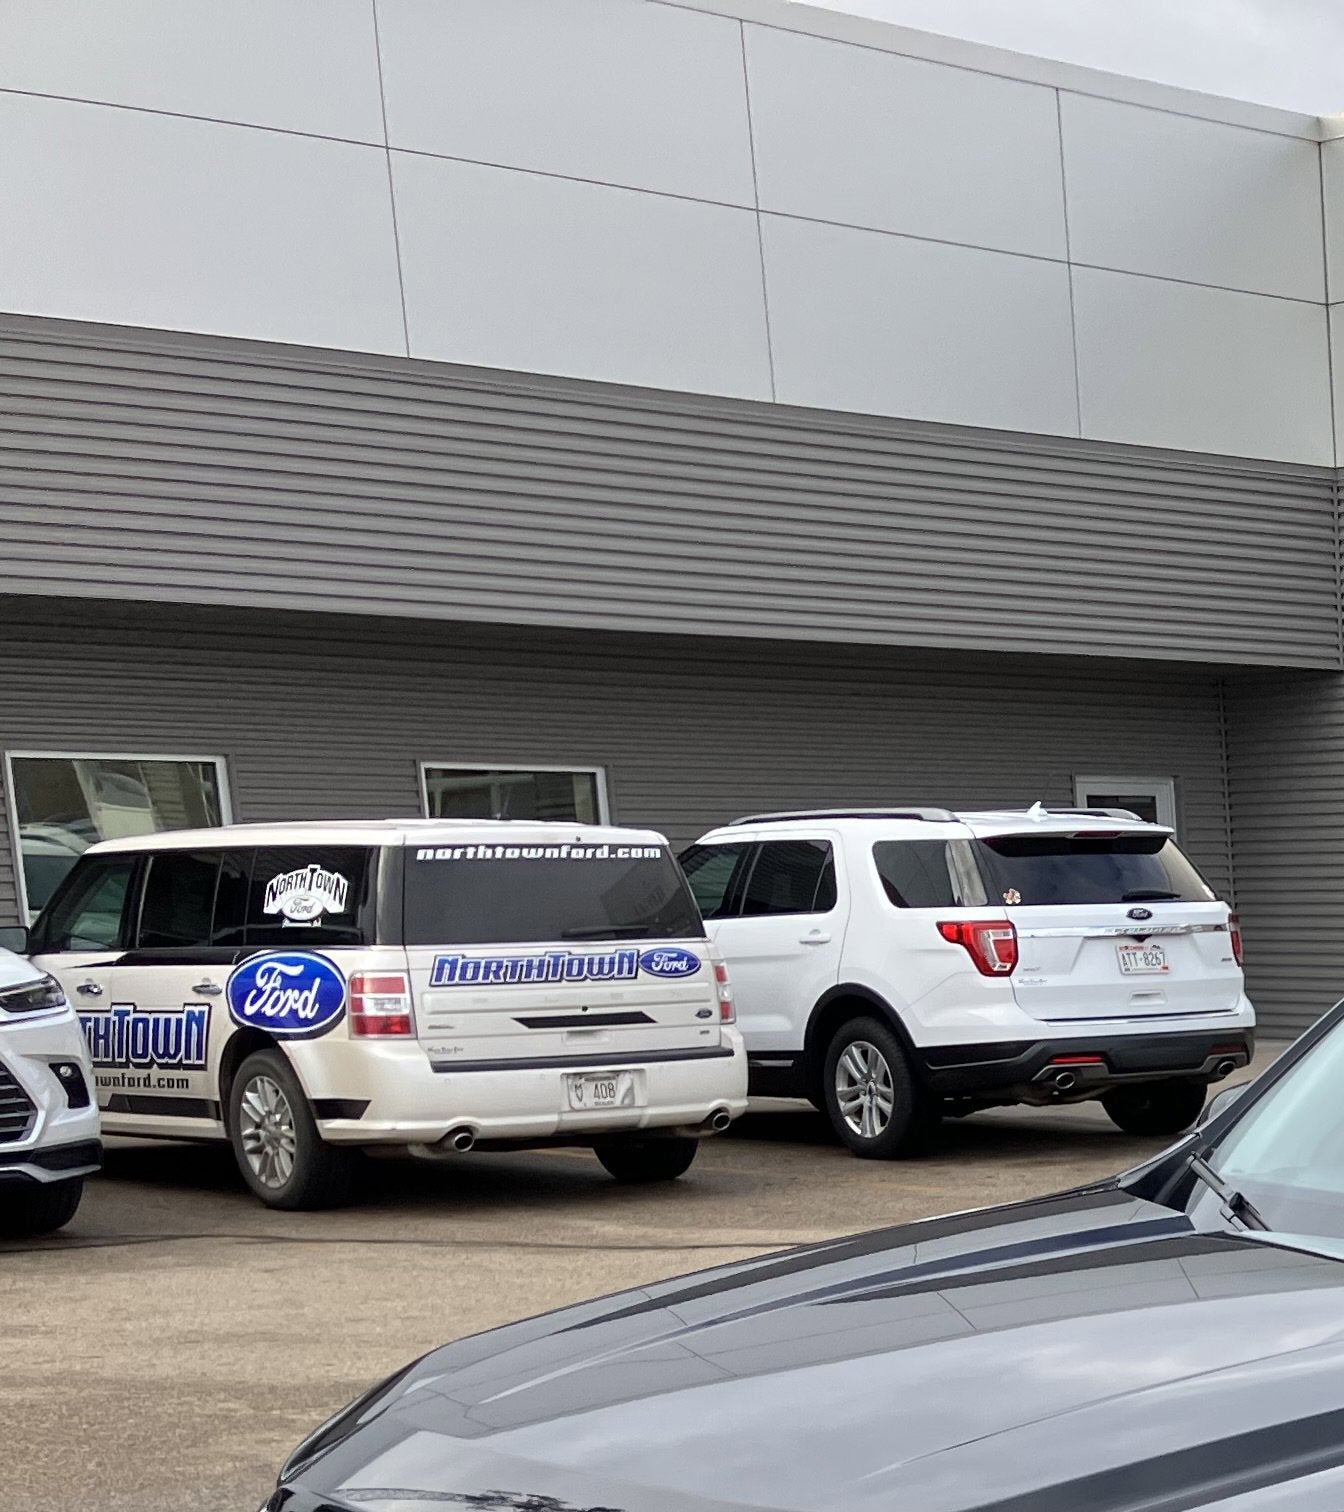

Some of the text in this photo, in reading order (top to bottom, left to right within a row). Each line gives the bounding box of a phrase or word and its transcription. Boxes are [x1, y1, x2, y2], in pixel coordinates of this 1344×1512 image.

[416, 845, 661, 861] northtownford.com
[289, 898, 316, 914] Ford
[651, 952, 690, 973] Ford
[243, 961, 321, 1020] Ford
